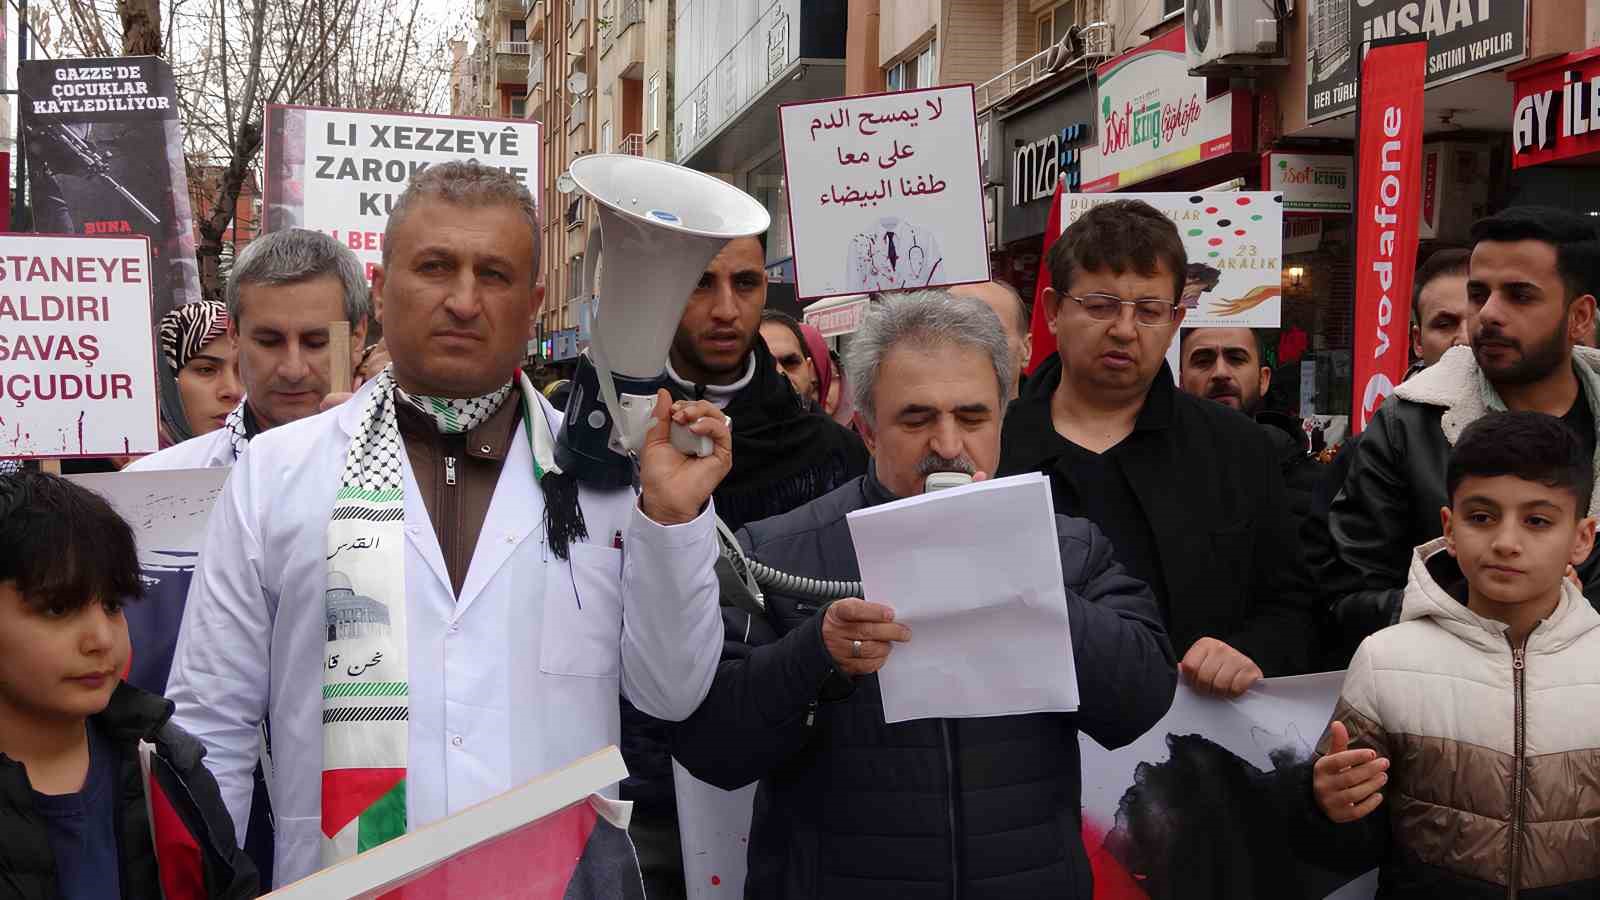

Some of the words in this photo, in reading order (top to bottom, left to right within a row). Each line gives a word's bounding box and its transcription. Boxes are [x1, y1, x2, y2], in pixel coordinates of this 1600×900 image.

[55, 65, 141, 81] GAZZE'DE
[1314, 91, 1331, 109] HER
[1429, 46, 1466, 75] SATIMI
[1469, 31, 1513, 61] YAPILIR
[51, 81, 148, 100] ÇOCUKLAR
[33, 95, 170, 114] KATLEDİLİYOR
[925, 96, 943, 120] لا
[810, 108, 850, 141] الدم
[858, 108, 919, 135] يمسح
[1512, 89, 1553, 155] AY
[327, 122, 357, 147] LI
[370, 125, 519, 156] XEZZEYÊ
[837, 146, 870, 165] معا
[878, 140, 914, 169] على
[817, 179, 893, 207] البيضاء
[900, 173, 947, 196] طفنا
[84, 220, 132, 236] BUNA
[1373, 105, 1401, 358] vodafone
[1216, 257, 1278, 269] ARALIK
[1236, 244, 1257, 257] 23
[0, 374, 133, 407] ÇUDUR
